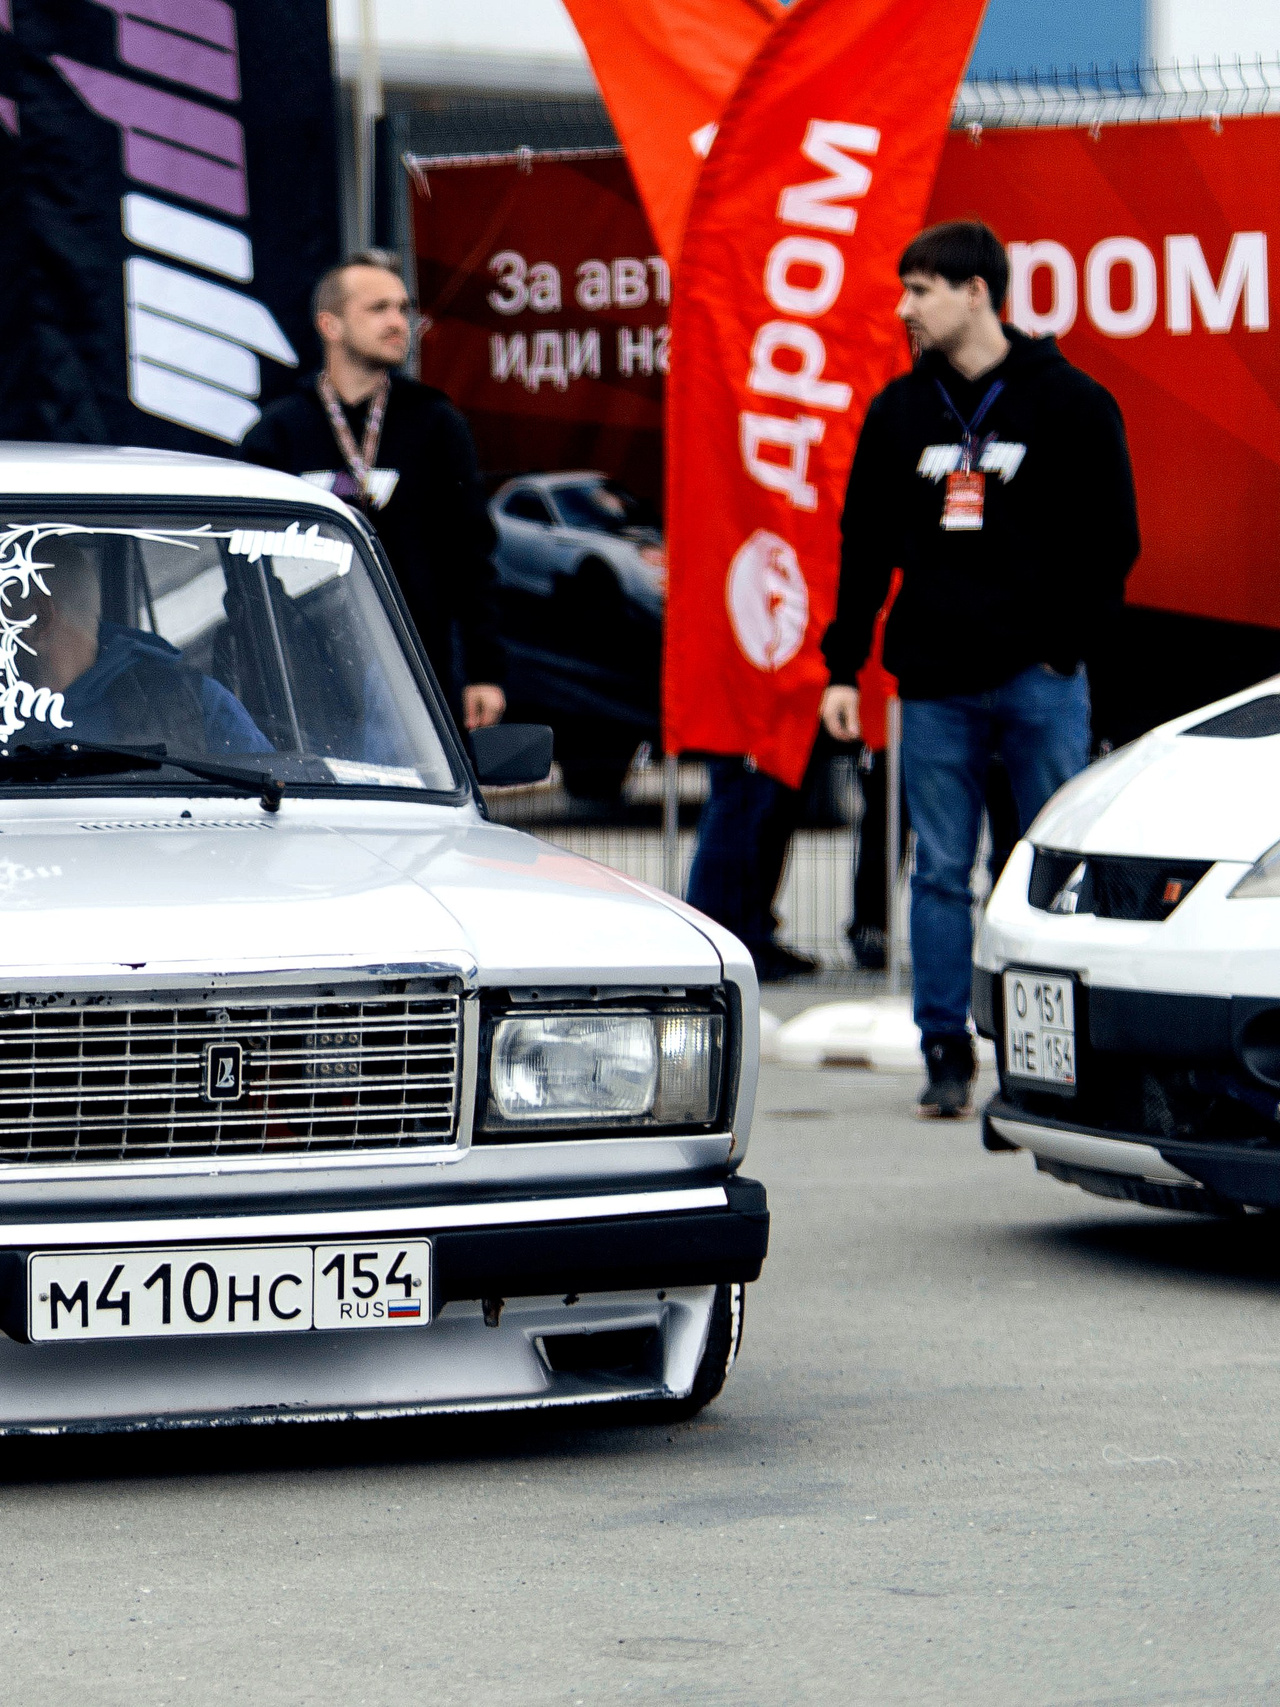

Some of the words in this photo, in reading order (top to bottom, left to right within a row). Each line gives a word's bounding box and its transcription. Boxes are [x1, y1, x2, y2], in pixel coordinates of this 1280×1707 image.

[487, 250, 561, 315] За
[1006, 231, 1269, 339] ром
[489, 326, 601, 393] иди
[322, 1251, 412, 1300] 154
[340, 1301, 385, 1319] RUS
